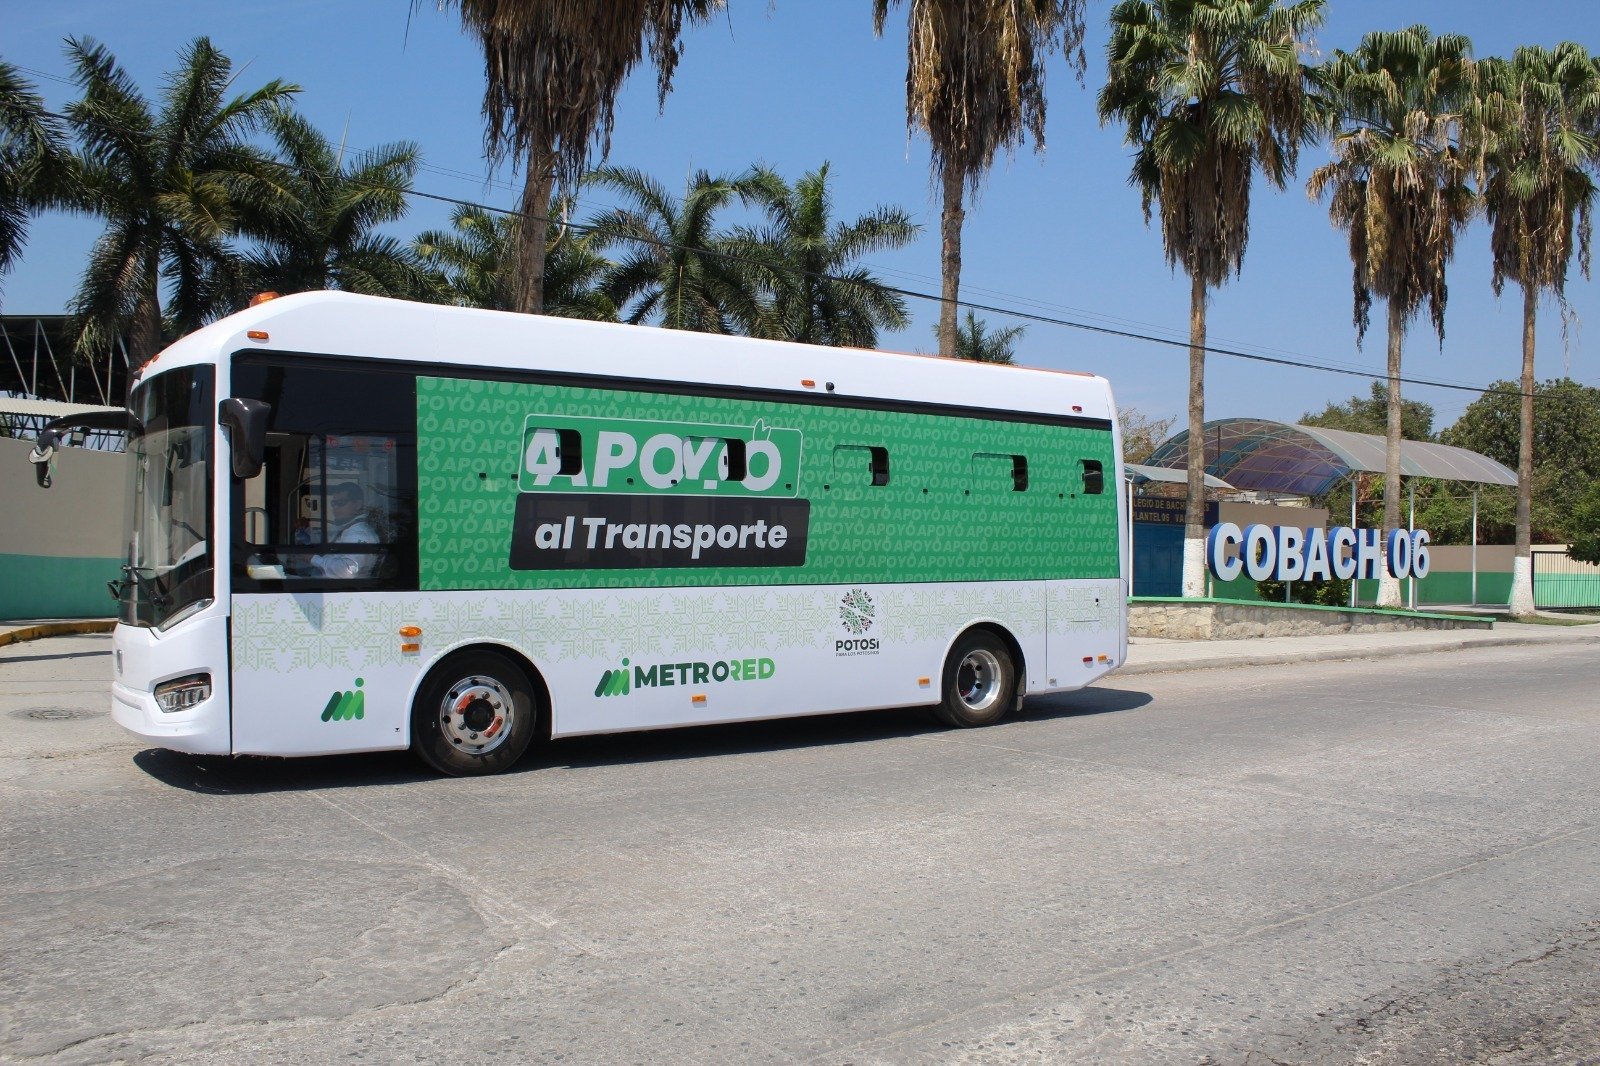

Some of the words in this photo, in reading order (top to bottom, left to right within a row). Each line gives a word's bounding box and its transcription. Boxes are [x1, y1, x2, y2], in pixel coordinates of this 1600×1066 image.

[1155, 499, 1164, 509] DE
[535, 516, 575, 550] al
[583, 517, 788, 560] Transporte
[1207, 522, 1382, 582] COBACH
[1387, 528, 1431, 580] 06
[634, 657, 776, 689] METRORED
